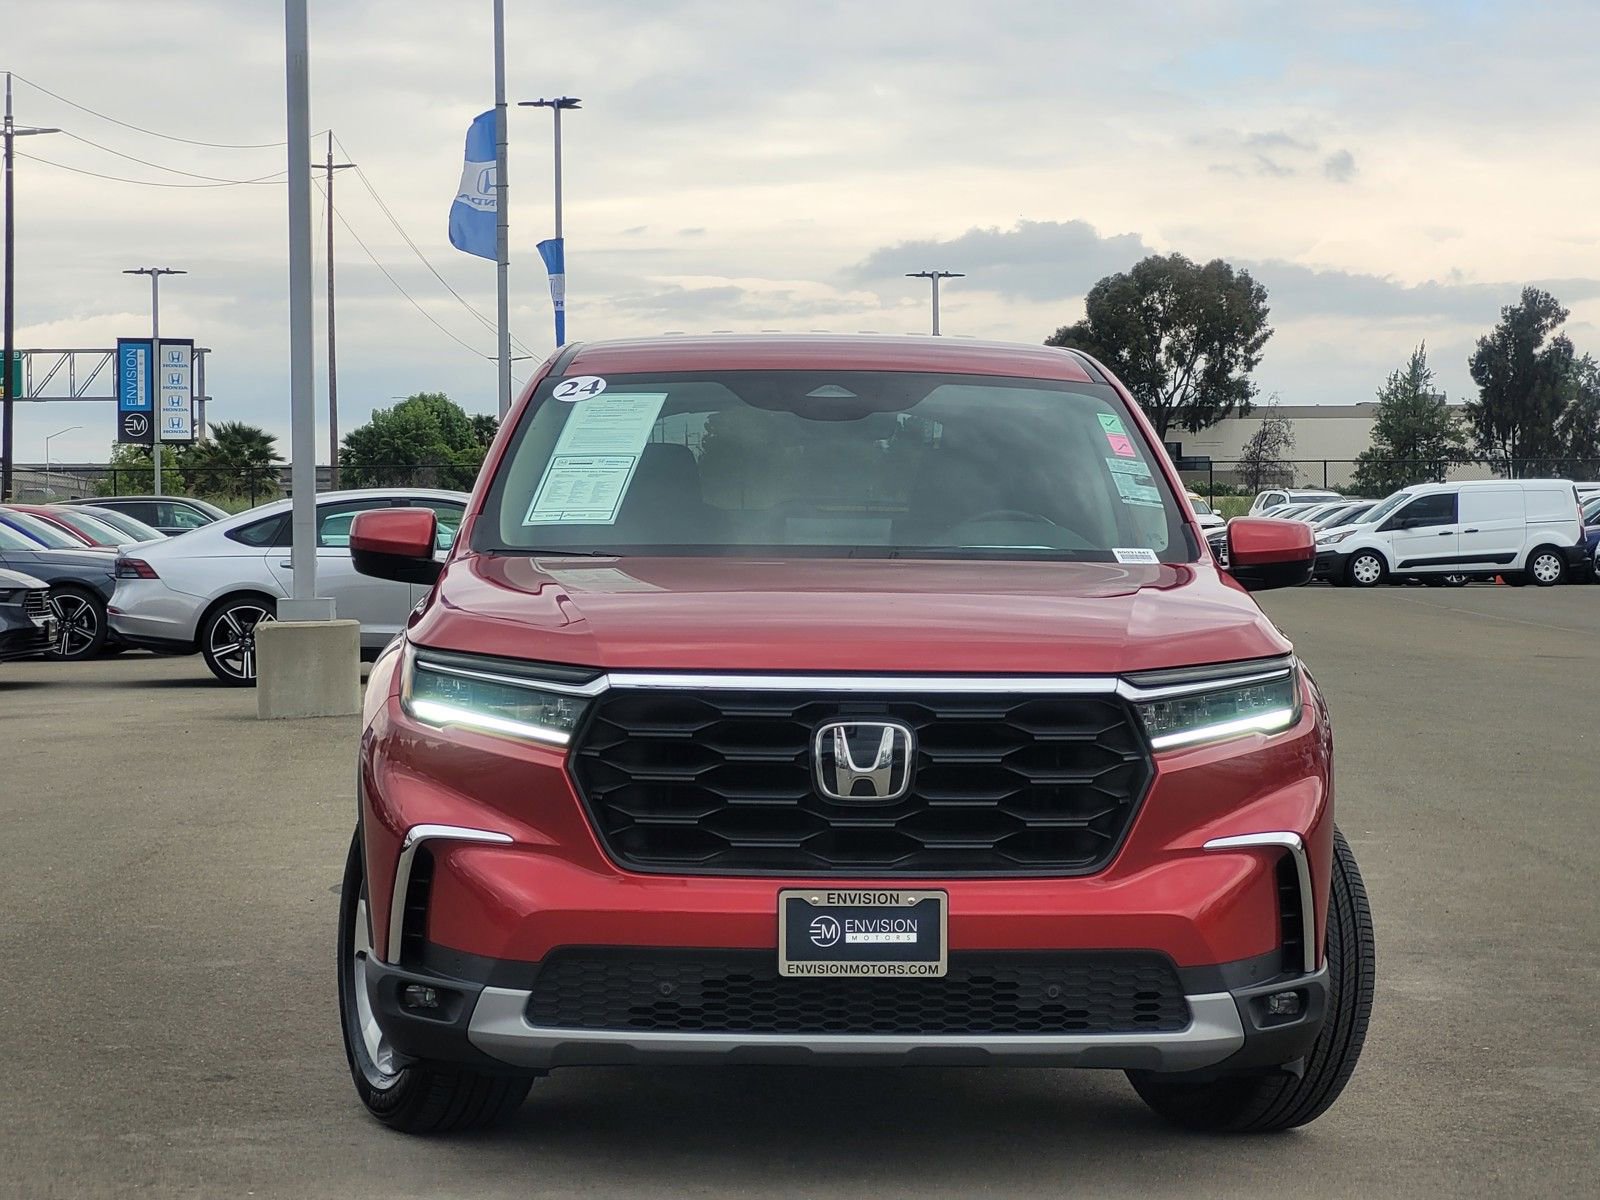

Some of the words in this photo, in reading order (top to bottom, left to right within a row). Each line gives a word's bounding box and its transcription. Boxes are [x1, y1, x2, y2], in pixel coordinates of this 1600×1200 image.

[127, 349, 136, 405] ENVISION
[557, 379, 601, 398] 24
[827, 893, 899, 904] ENVISION
[845, 919, 918, 932] ENVISION
[787, 964, 939, 975] ENVISIONMOTORS.COM
